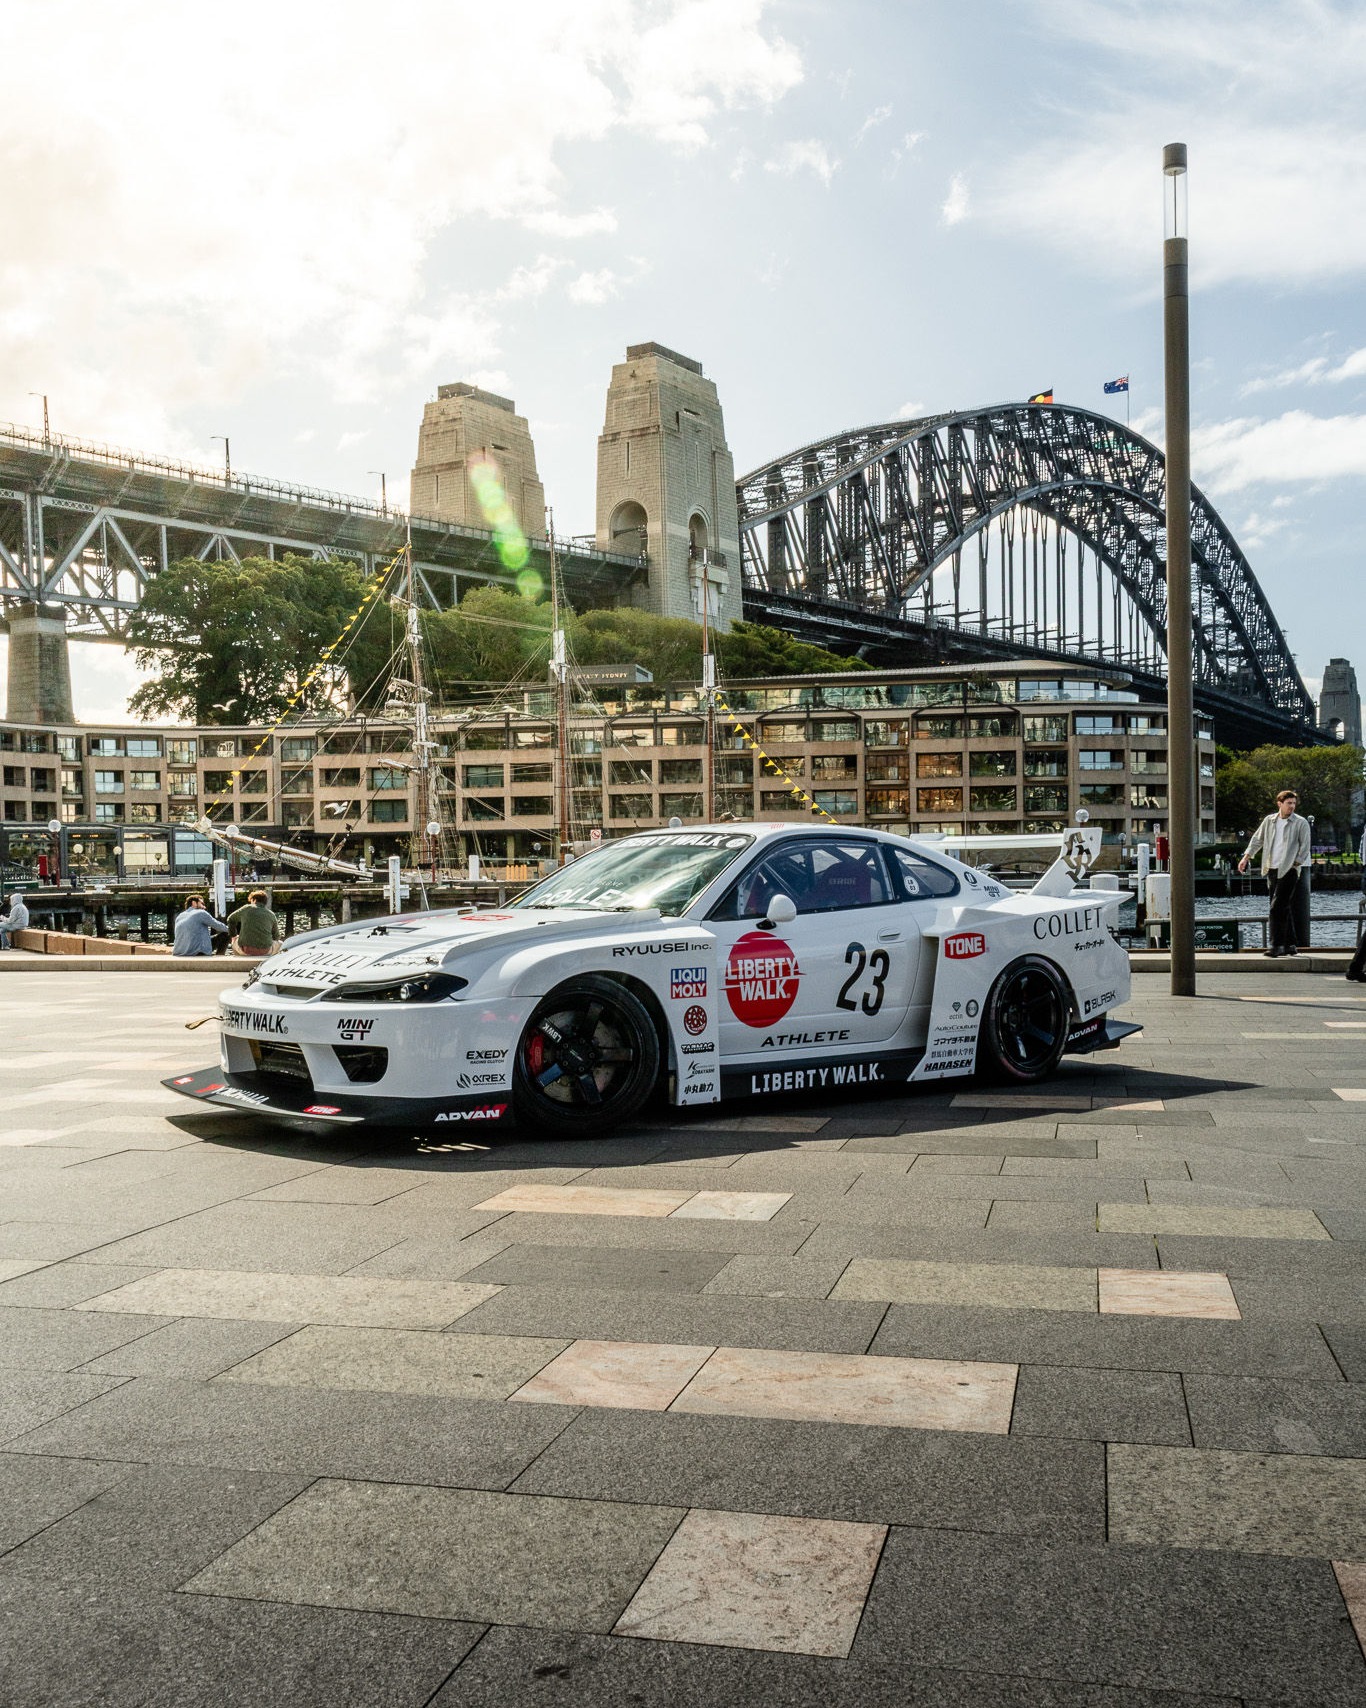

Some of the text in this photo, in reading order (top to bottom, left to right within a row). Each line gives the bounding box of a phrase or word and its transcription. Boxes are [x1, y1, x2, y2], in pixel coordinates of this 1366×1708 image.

[670, 834, 730, 847] WALK
[1033, 906, 1102, 940] COLLET
[612, 942, 689, 957] RYUUSEI
[947, 936, 983, 956] TONE
[1203, 943, 1233, 951] Services
[287, 952, 372, 970] COLLET
[724, 957, 799, 980] LIBERTY
[262, 967, 348, 985] ATHLETE
[671, 969, 706, 983] LIQUI
[835, 941, 890, 1017] 23
[671, 983, 706, 998] MOLY
[337, 1018, 374, 1030] MINI
[340, 1029, 371, 1041] GT
[542, 1022, 562, 1043] LBWK
[760, 1029, 851, 1048] ATHLETE
[1067, 1023, 1098, 1042] ADVAN
[466, 1049, 509, 1060] EXEDY
[924, 1059, 973, 1073] HARASEN
[751, 1067, 829, 1094] LIBERTY
[434, 1109, 501, 1122] ADVAN
